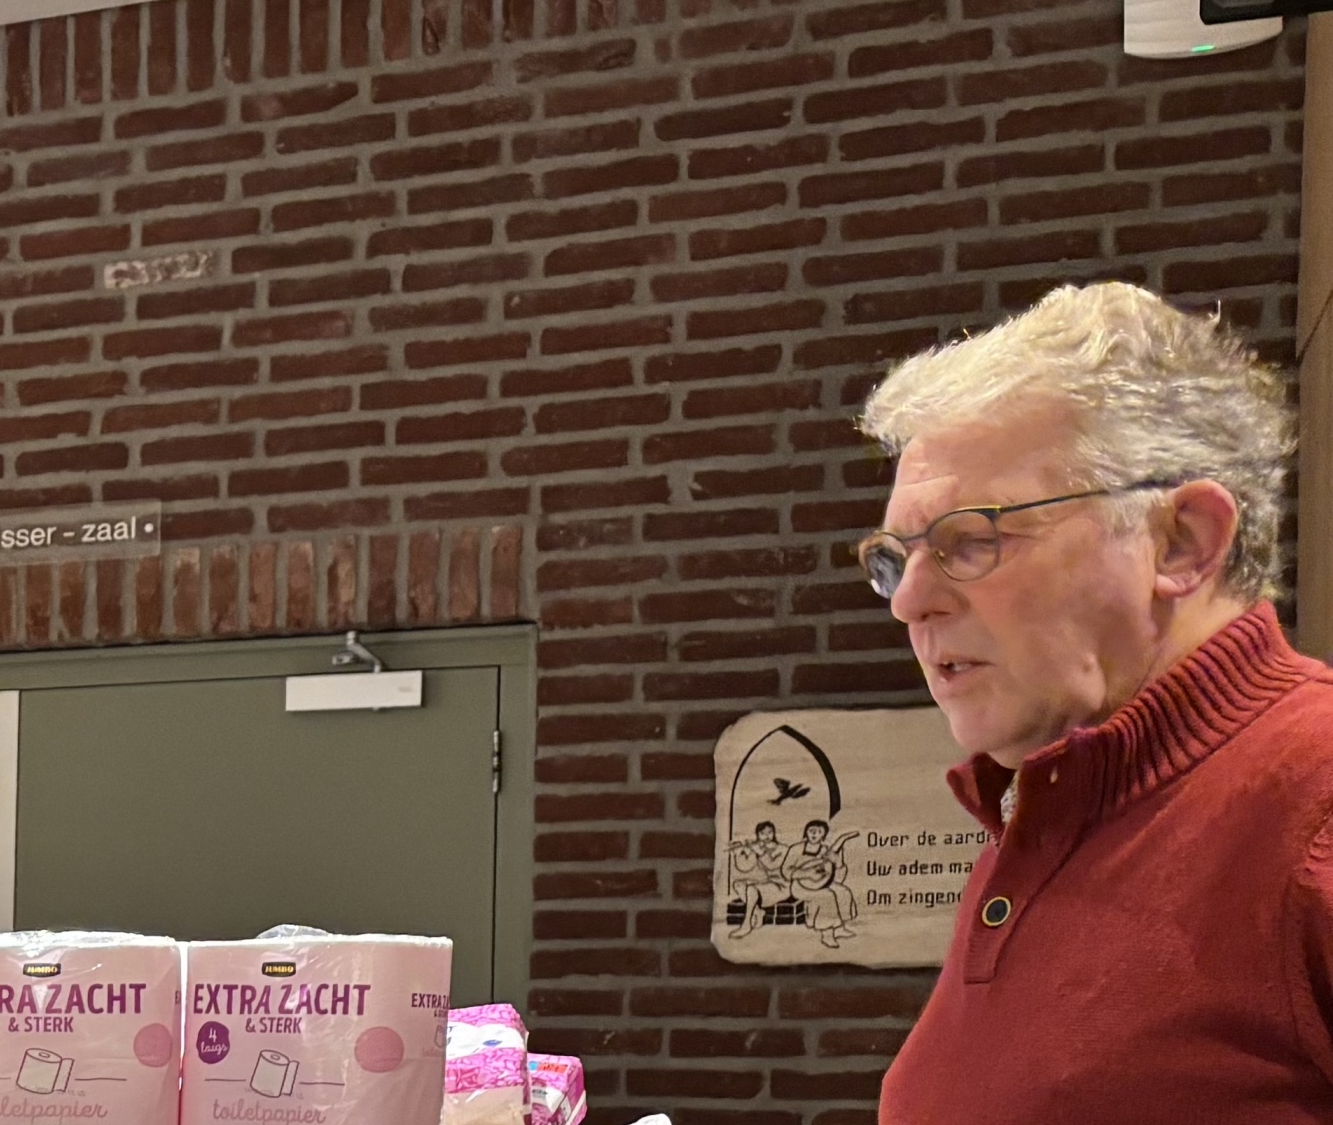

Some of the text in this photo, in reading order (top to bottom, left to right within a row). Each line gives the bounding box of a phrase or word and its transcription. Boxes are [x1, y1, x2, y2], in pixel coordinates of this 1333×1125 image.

[867, 831, 909, 848] Over
[917, 830, 937, 846] de
[867, 860, 892, 876] Uw
[898, 859, 943, 876] adem
[867, 889, 892, 906] Om
[44, 983, 147, 1014] ZACHT
[193, 983, 371, 1016] EXTRA ZACHT
[8, 1016, 74, 1033] & STERK
[245, 1017, 302, 1034] & STERK
[208, 1027, 218, 1041] 4
